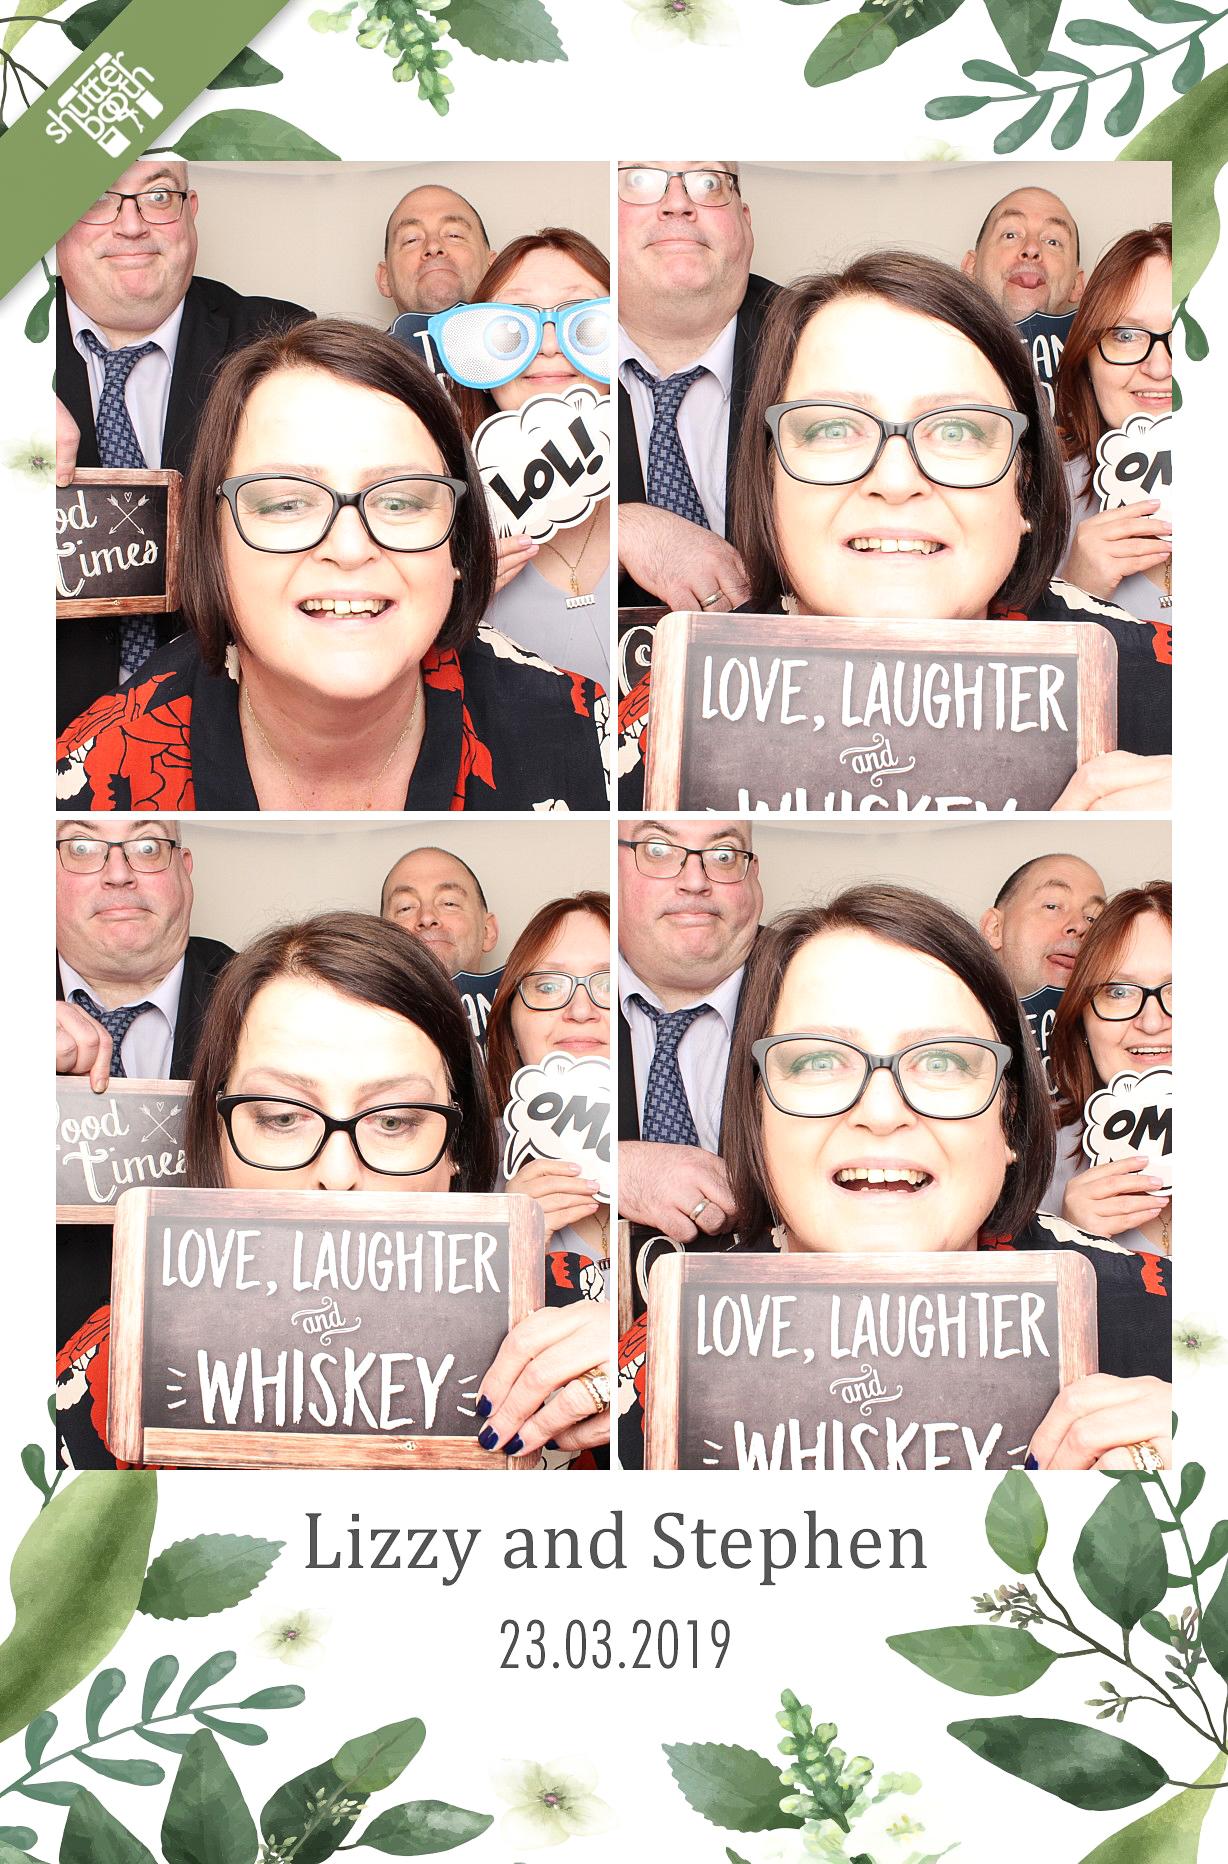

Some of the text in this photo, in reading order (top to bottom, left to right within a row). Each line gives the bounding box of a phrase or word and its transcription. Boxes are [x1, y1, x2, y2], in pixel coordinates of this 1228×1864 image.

[488, 416, 604, 520] LOL!
[702, 656, 825, 732] LOVE,
[841, 660, 1069, 733] LAUGHTER
[848, 736, 901, 777] and
[162, 1227, 501, 1296] LOVE, LAUGHTER
[299, 1298, 350, 1337] and
[697, 1292, 1051, 1365] LOVE, LAUGHTER
[197, 1347, 455, 1431] WHISKEY
[839, 1365, 891, 1407] and
[733, 1417, 1003, 1470] WHISKEY
